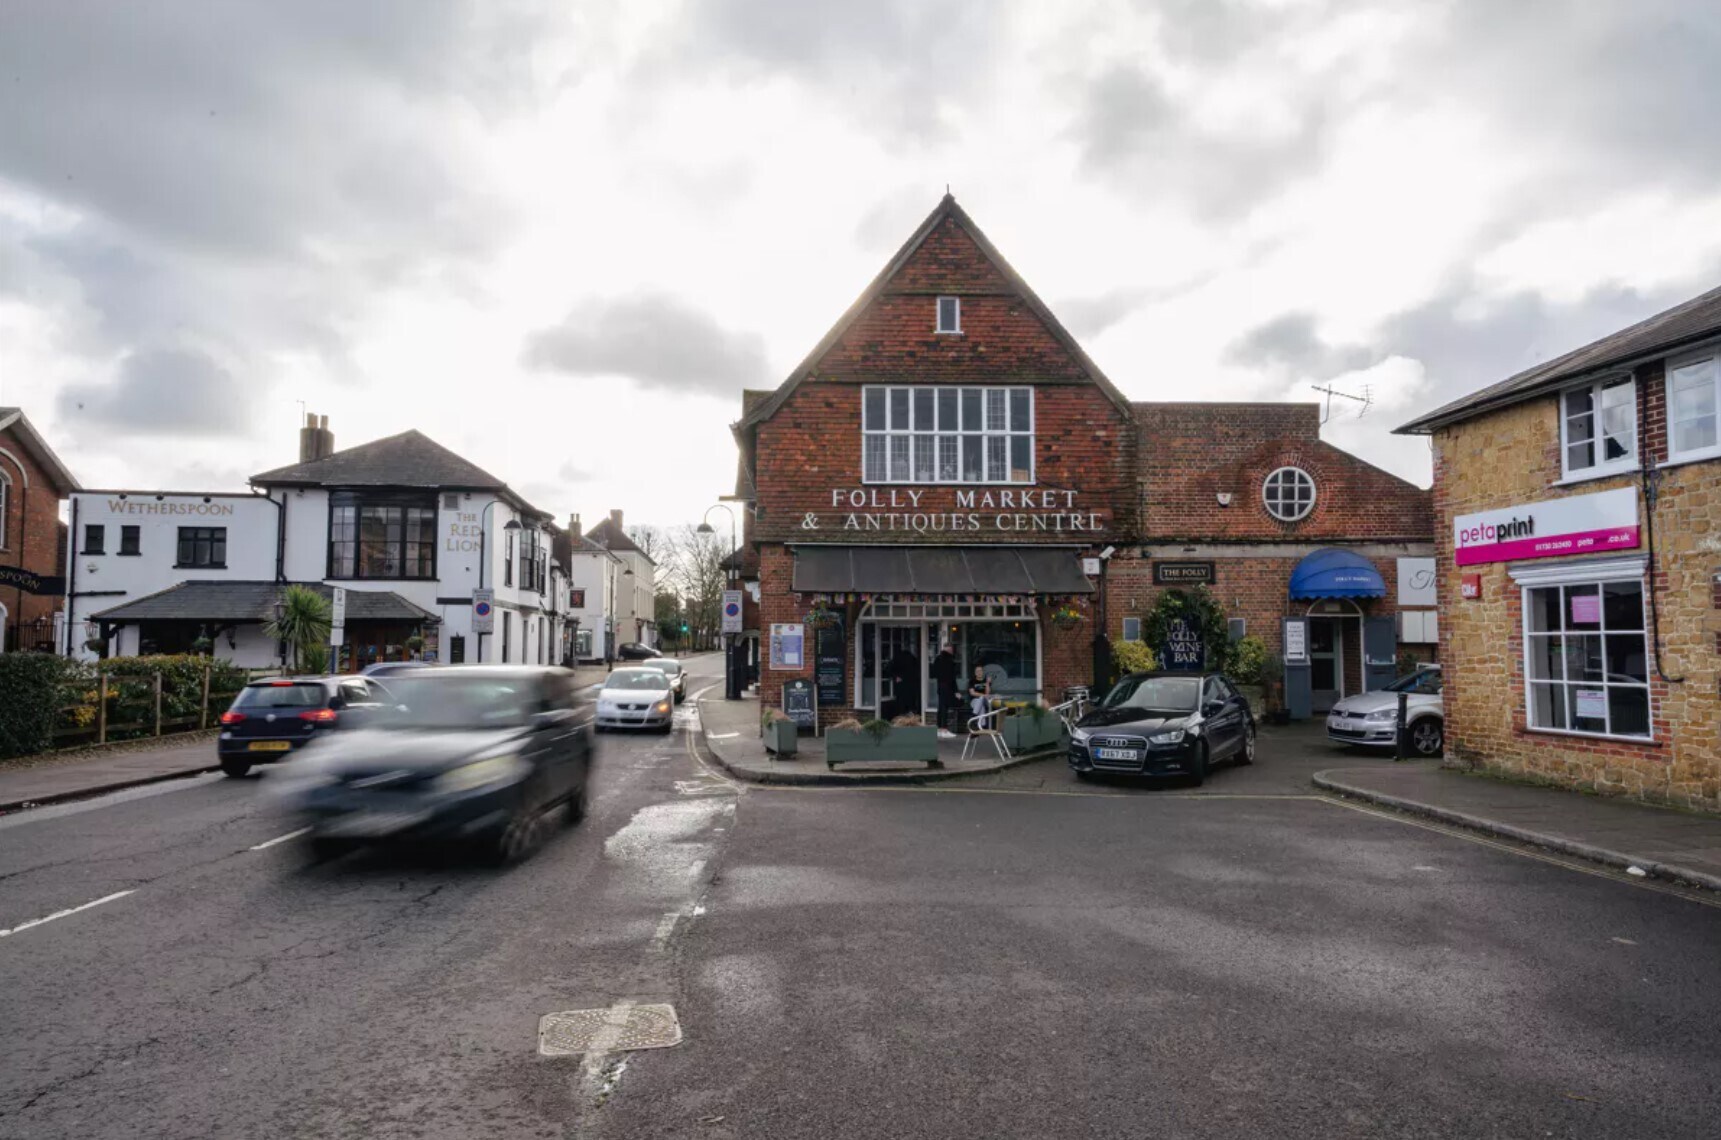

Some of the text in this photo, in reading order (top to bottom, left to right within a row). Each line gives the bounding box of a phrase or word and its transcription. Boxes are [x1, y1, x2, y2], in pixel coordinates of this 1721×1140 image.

[831, 489, 1079, 509] FOLLY MARKET
[455, 512, 477, 521] THE
[801, 511, 1103, 534] & ANTIQUES CENTRE
[451, 523, 482, 537] RED
[1460, 514, 1534, 549] petaprint
[446, 538, 482, 551] LION
[1577, 532, 1630, 548] peta.co.uk
[1163, 568, 1207, 577] THE FOLLY
[1173, 652, 1198, 663] BAR
